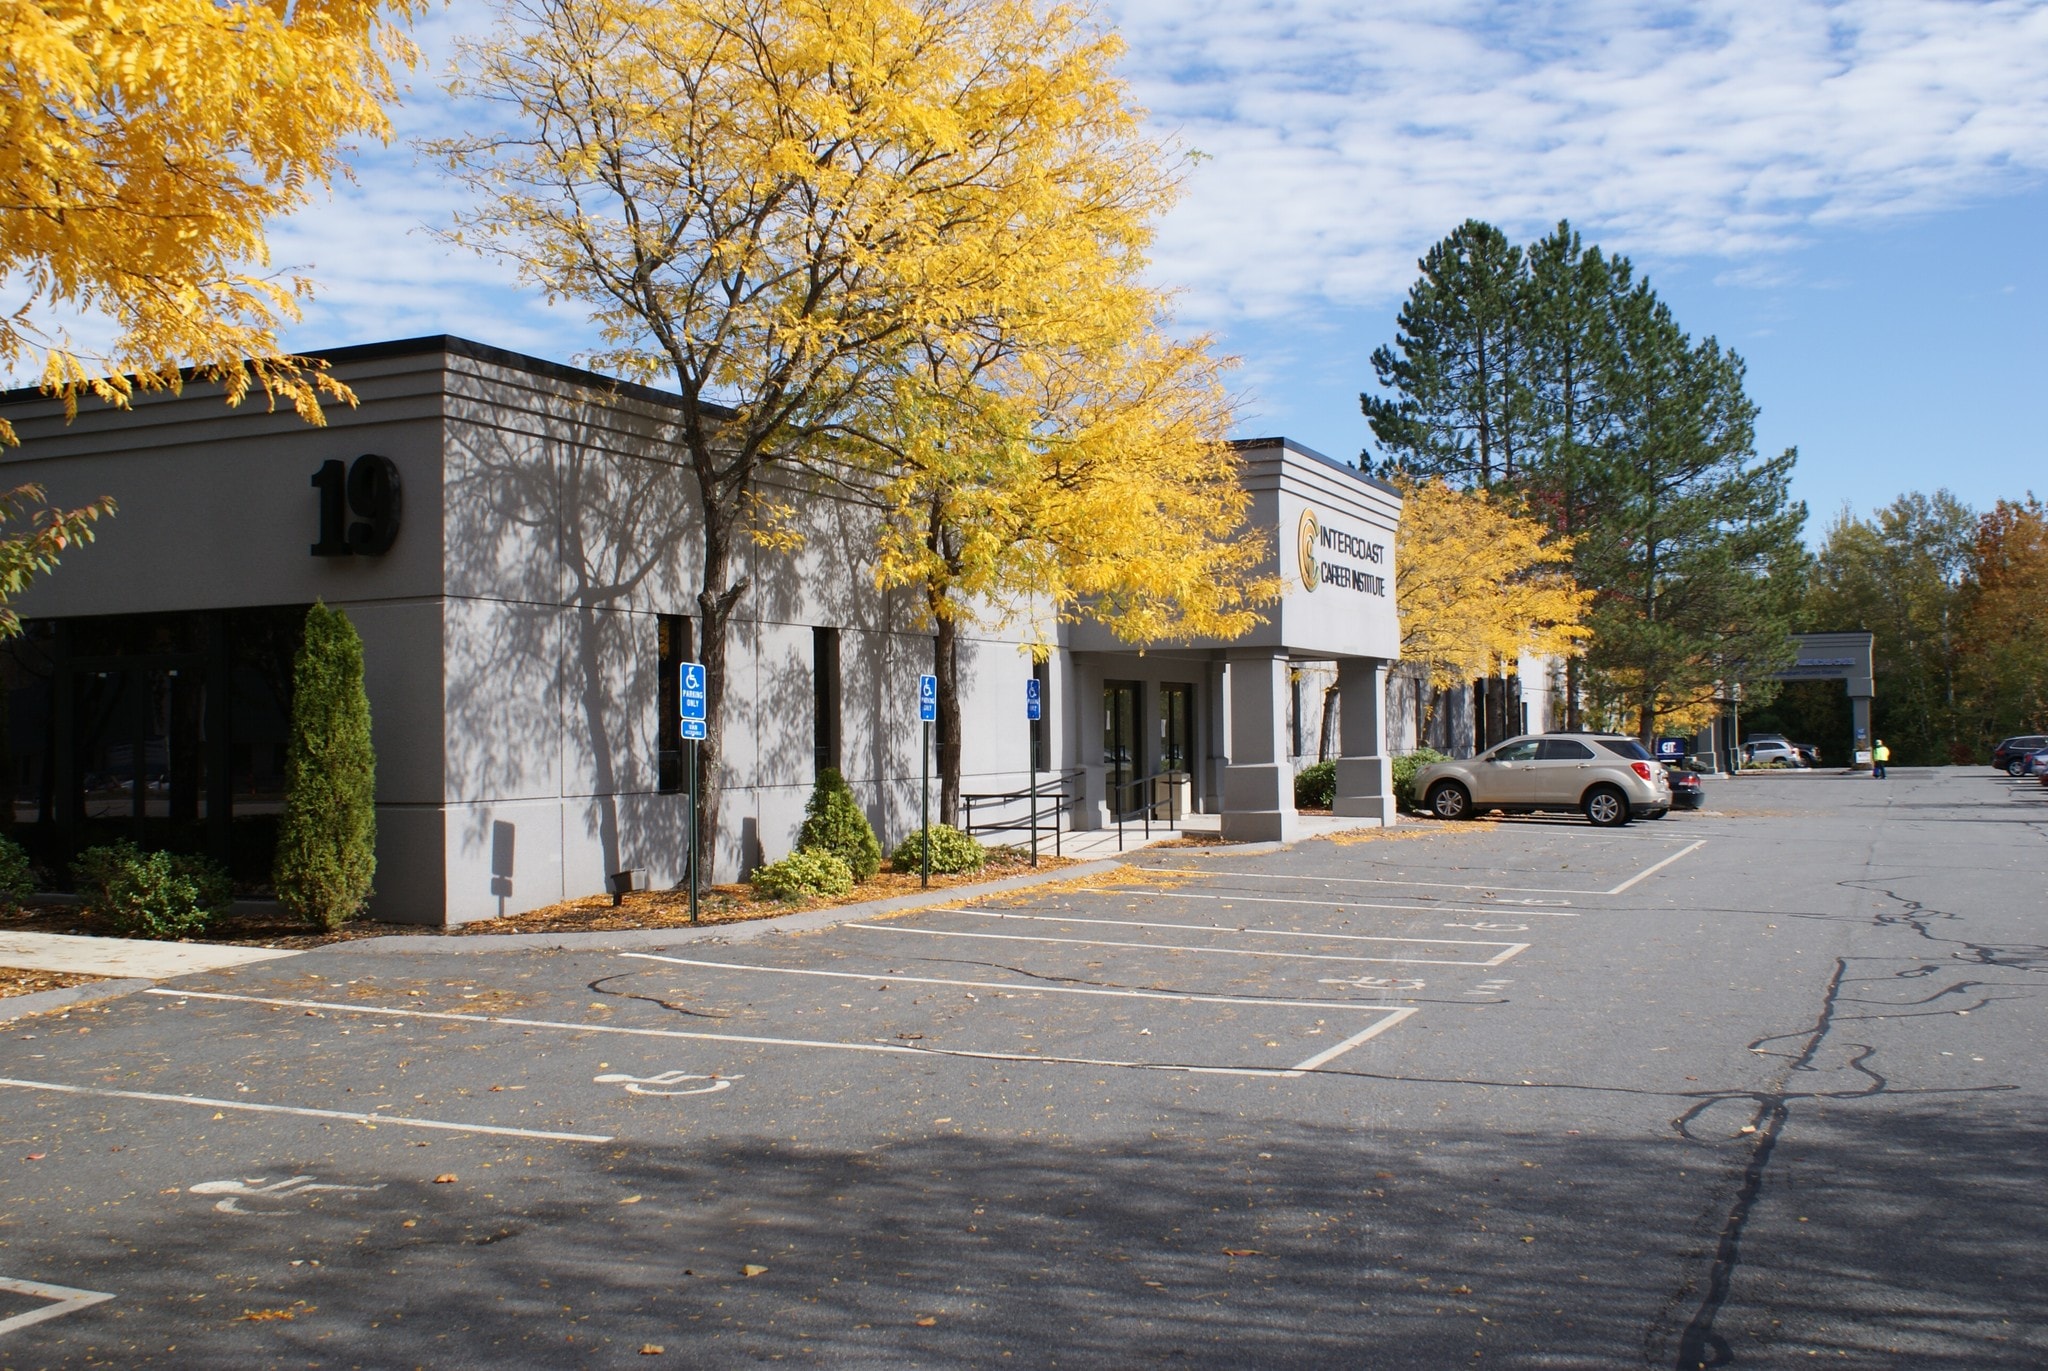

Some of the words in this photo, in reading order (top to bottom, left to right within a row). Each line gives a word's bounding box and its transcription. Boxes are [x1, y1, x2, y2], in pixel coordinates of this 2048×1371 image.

[310, 454, 402, 556] 19
[1320, 525, 1384, 565] INTERCOAST
[1320, 561, 1351, 589] CAREER
[1352, 569, 1385, 598] INSTITUTE
[682, 689, 703, 699] PARKING
[686, 699, 699, 707] ONLY
